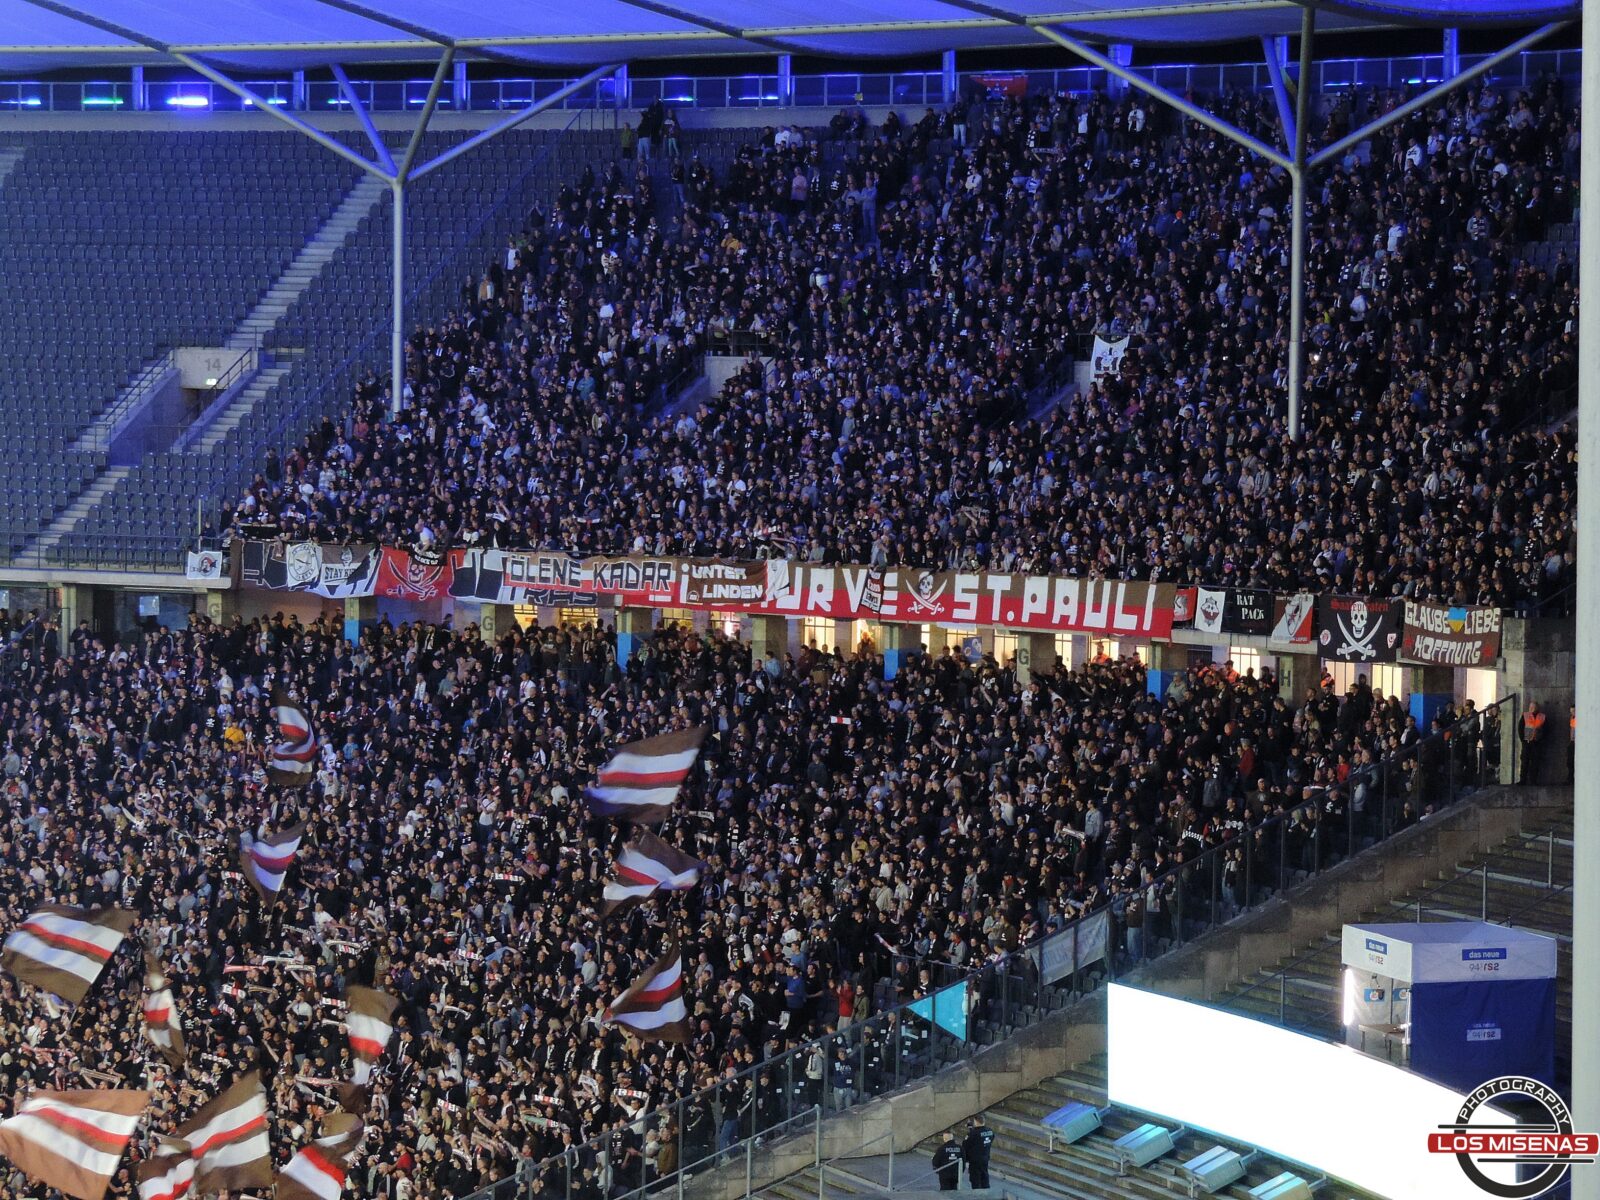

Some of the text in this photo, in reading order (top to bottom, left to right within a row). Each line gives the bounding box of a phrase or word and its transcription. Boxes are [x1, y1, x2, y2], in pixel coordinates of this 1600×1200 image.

[204, 358, 221, 371] 14
[324, 566, 342, 580] STAY
[511, 554, 581, 588] ÖLENE
[593, 561, 672, 591] KADAR
[692, 564, 747, 580] UNTER
[703, 584, 763, 599] LINDEN
[761, 564, 898, 614] URVE
[952, 574, 1157, 631] ST.PAULI
[1236, 594, 1255, 606] RAT
[208, 603, 220, 618] G
[1241, 607, 1265, 620] PACK
[1405, 601, 1501, 635] GLAUBE LIEBE
[482, 616, 494, 631] G
[1019, 648, 1029, 666] G
[1413, 634, 1482, 665] HOFFNUNG
[1281, 669, 1291, 687] H
